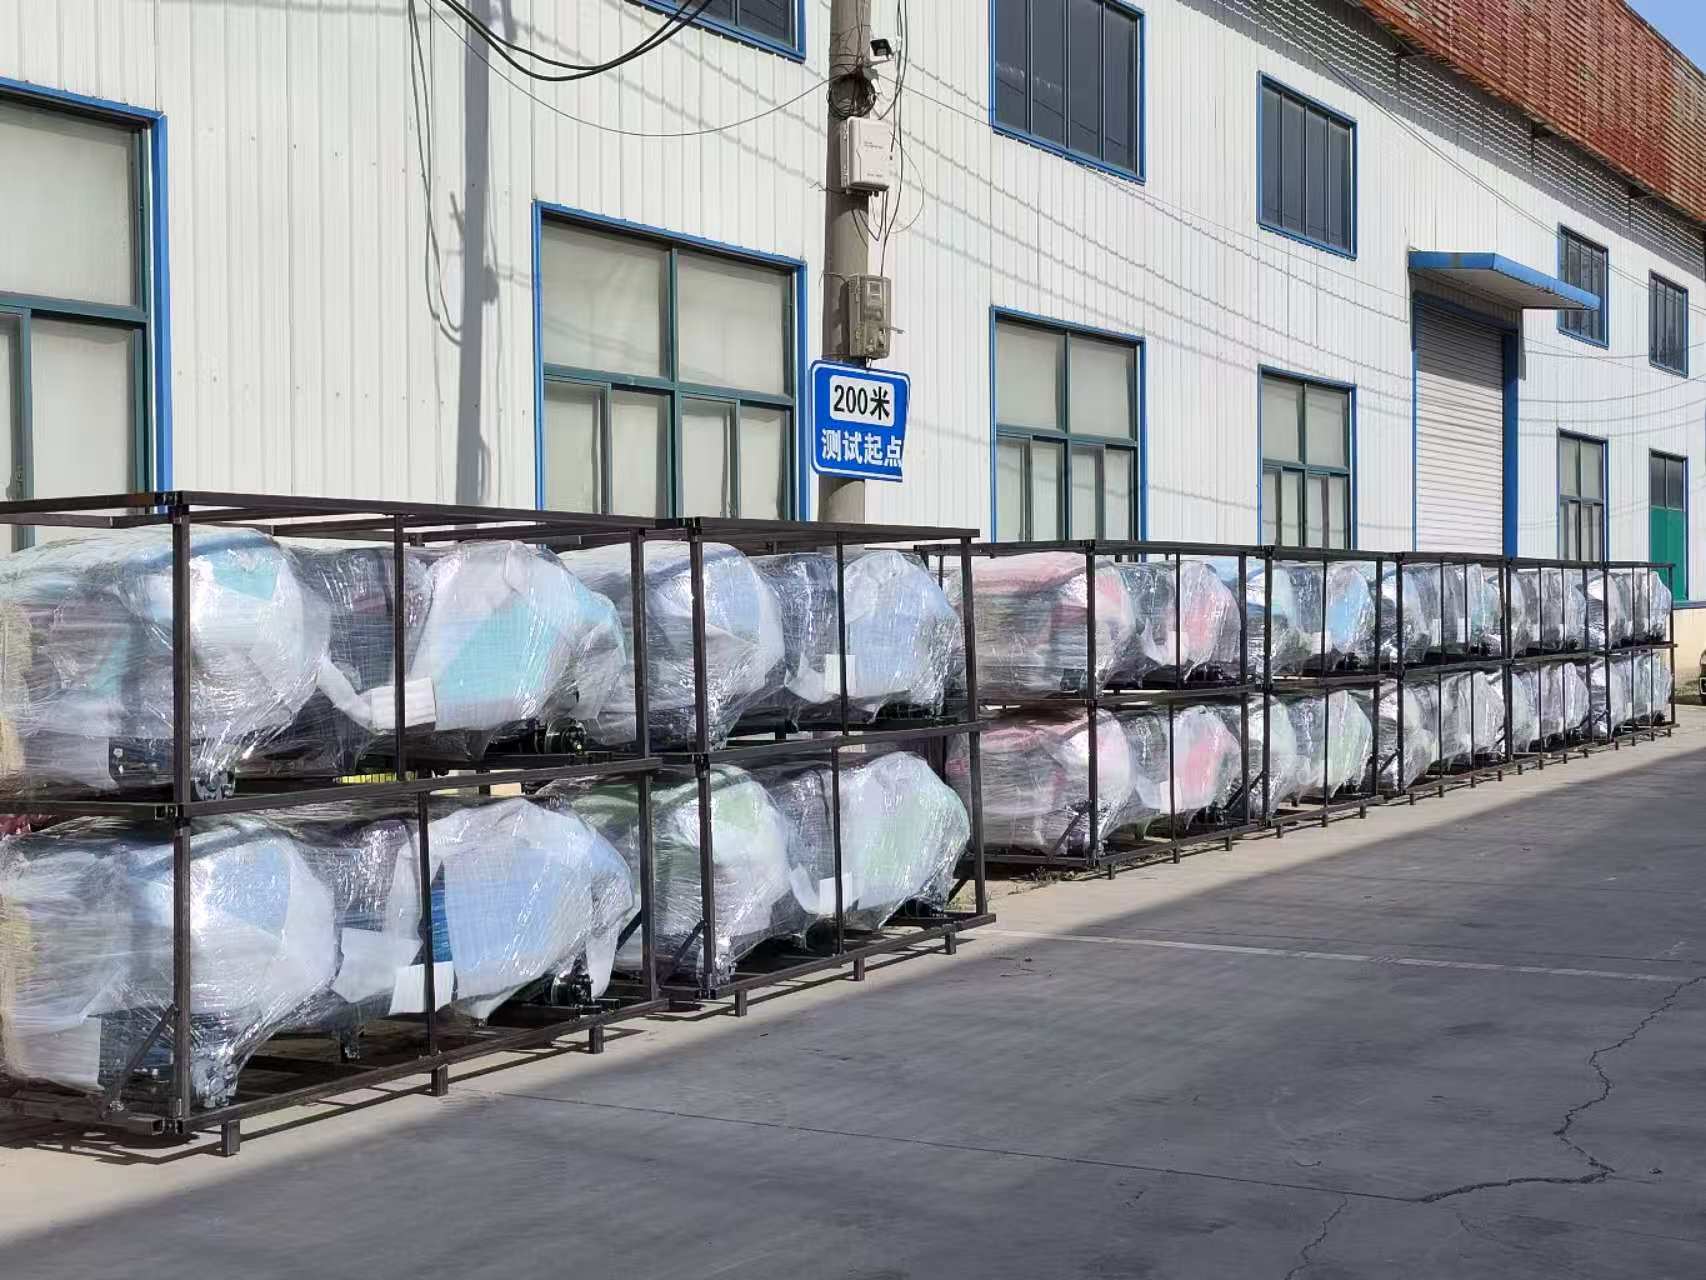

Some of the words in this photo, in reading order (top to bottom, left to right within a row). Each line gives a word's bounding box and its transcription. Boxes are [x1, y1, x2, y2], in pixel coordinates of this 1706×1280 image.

[834, 385, 890, 420] 200米
[821, 428, 902, 467] 测试起点
